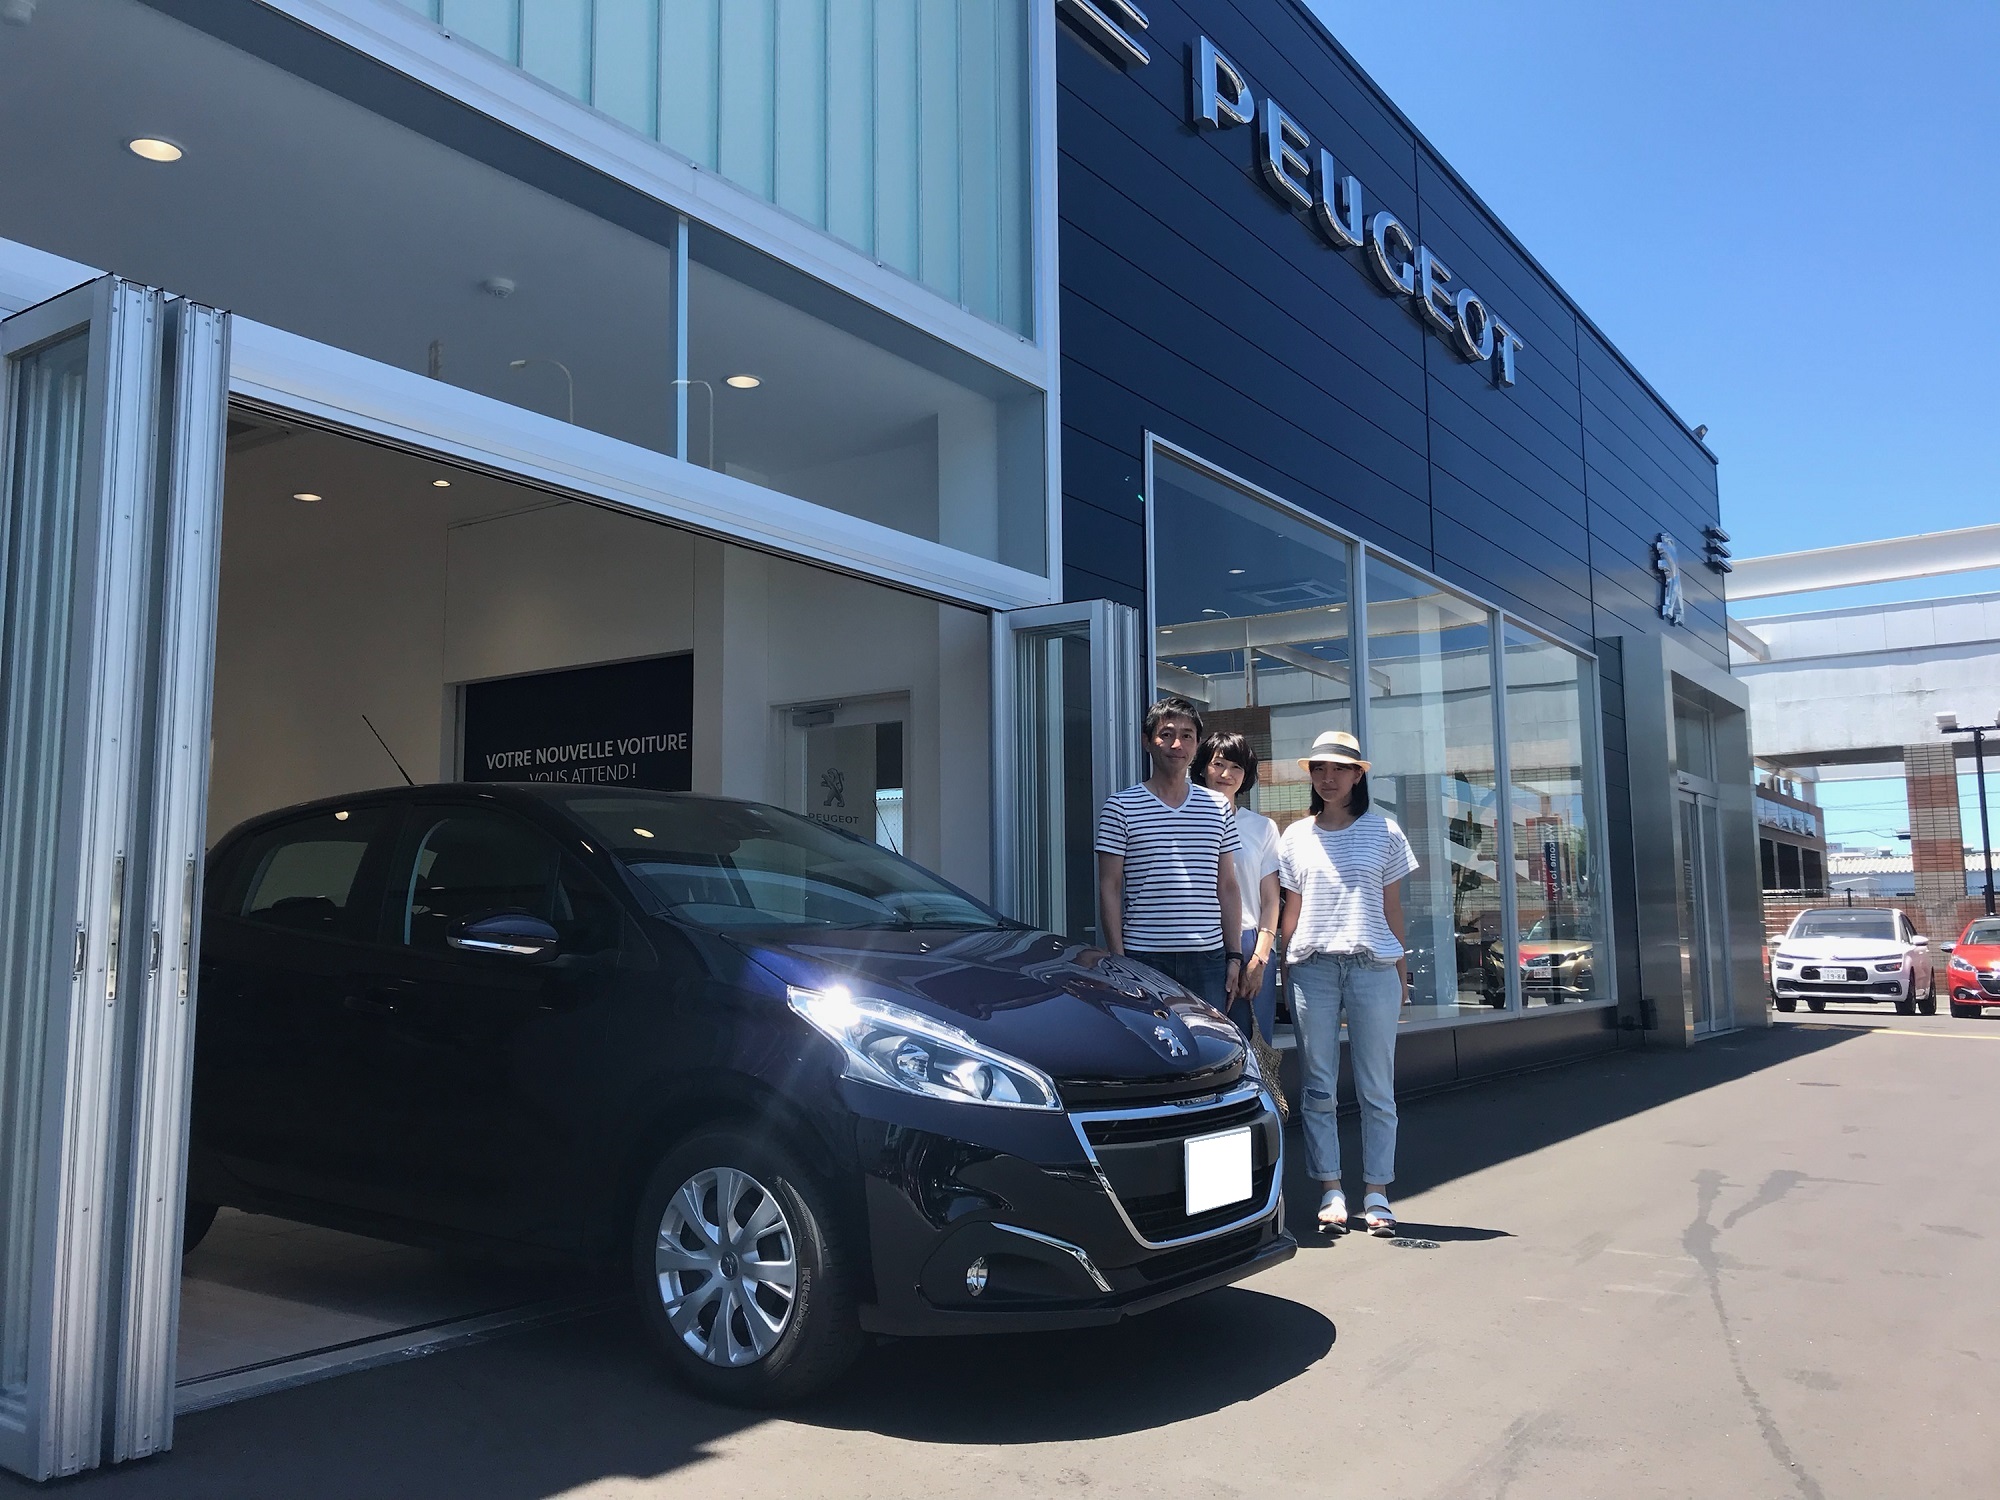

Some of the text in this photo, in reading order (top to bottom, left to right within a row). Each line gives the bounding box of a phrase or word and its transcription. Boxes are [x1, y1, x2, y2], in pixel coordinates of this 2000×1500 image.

[1191, 35, 1523, 388] PEUGEOT
[486, 732, 688, 770] VOTRE NOUVELLE VOITURE
[808, 812, 859, 824] PEUGEOT
